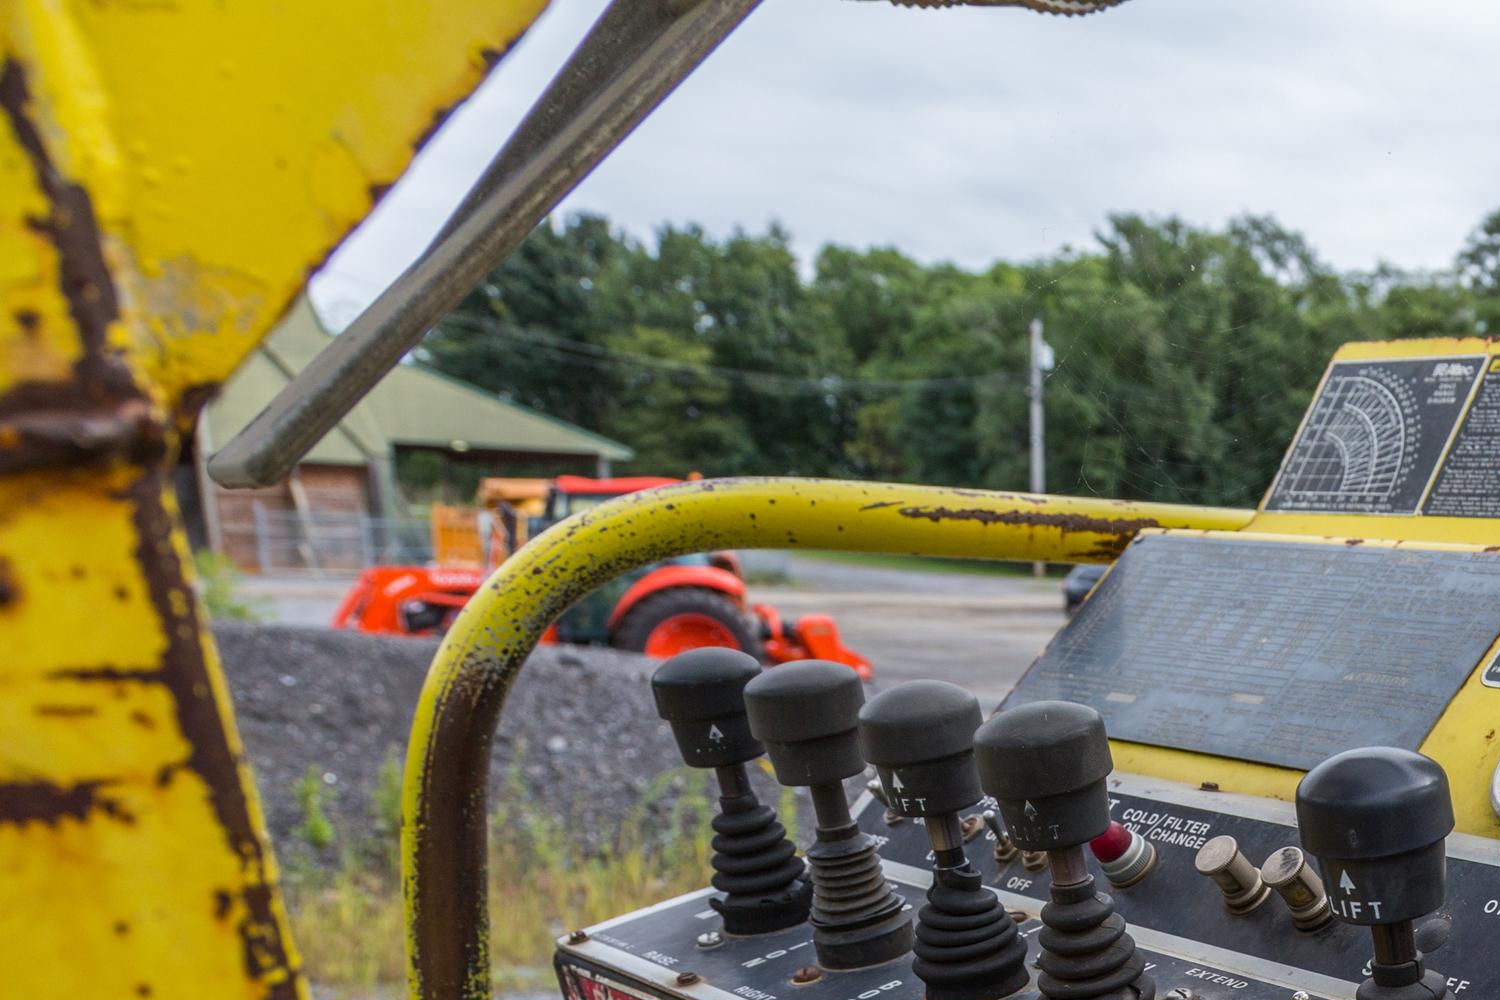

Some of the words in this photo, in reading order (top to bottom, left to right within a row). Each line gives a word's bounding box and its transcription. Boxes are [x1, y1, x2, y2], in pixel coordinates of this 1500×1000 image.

[1007, 876, 1032, 892] OFF
[1329, 896, 1382, 919] LIFT
[1185, 968, 1248, 990] EXTEND
[1446, 977, 1470, 994] FF
